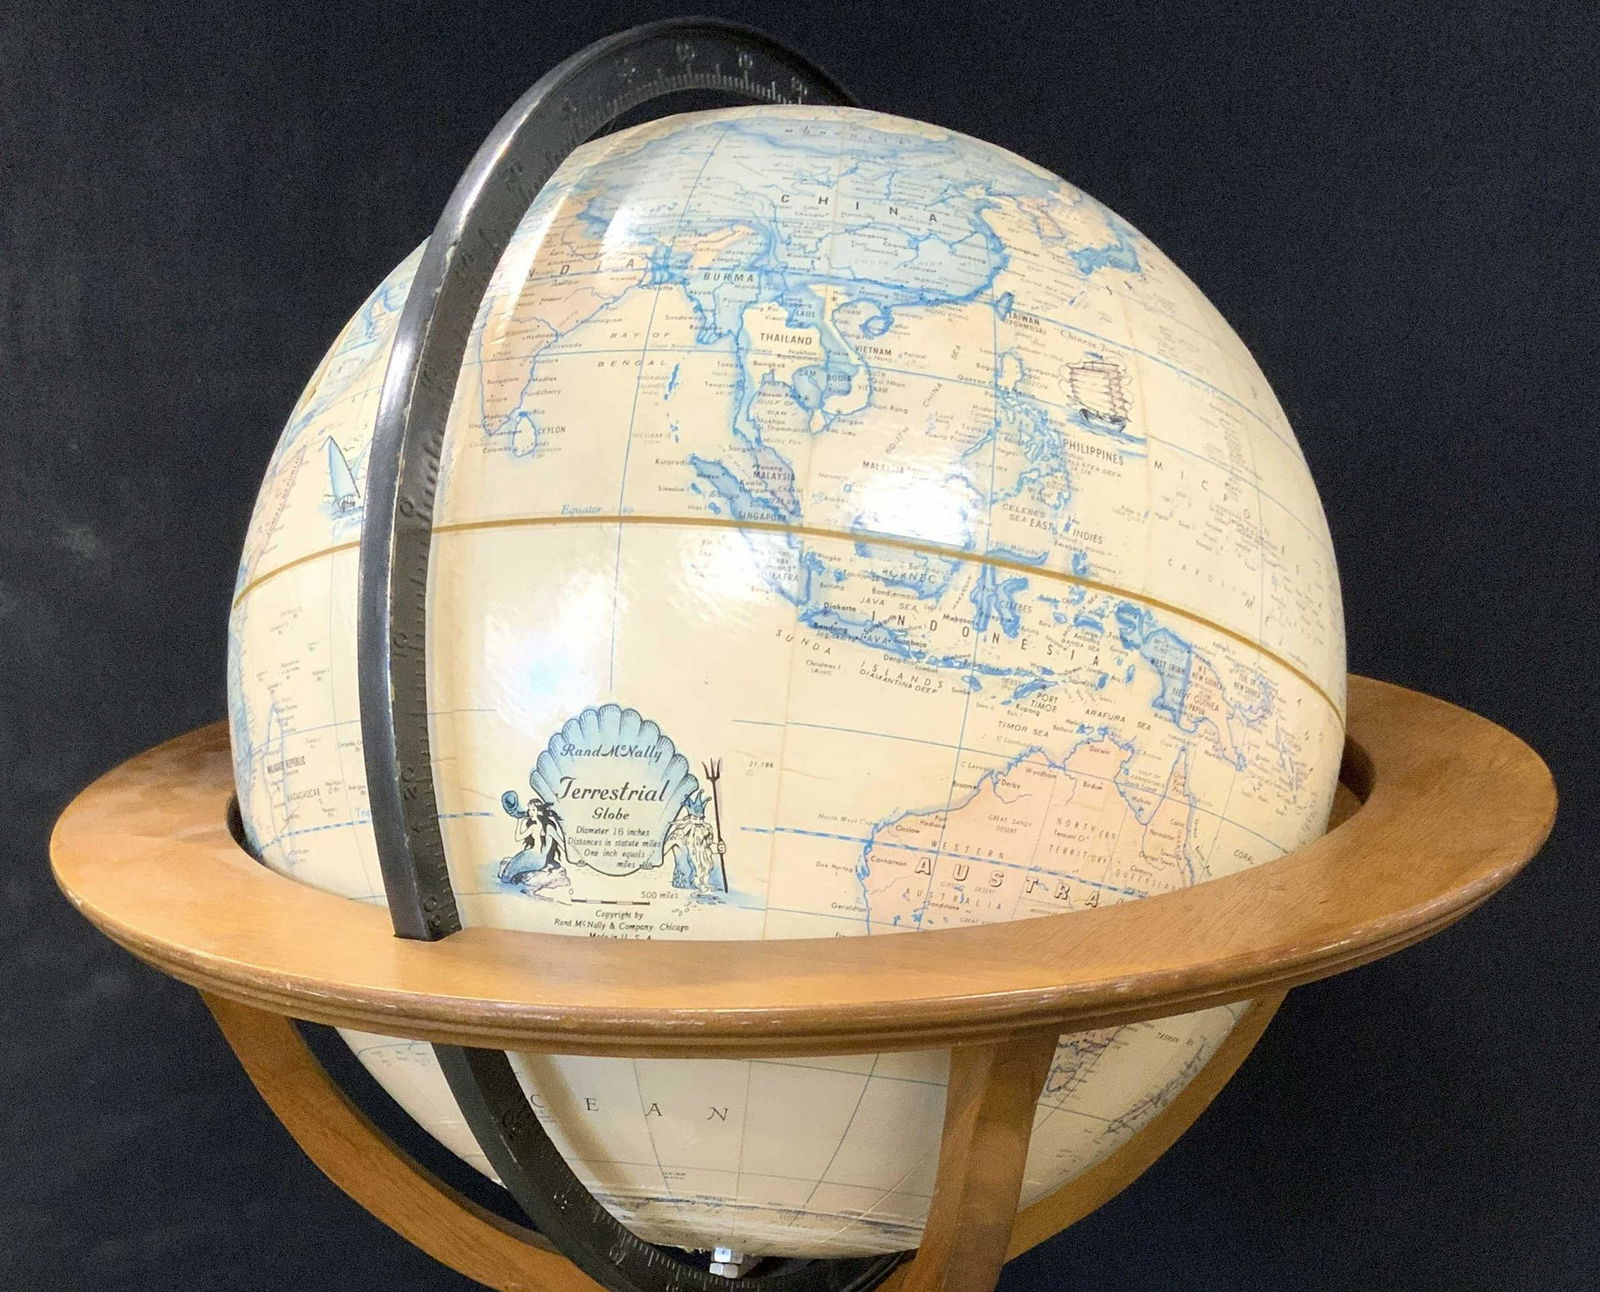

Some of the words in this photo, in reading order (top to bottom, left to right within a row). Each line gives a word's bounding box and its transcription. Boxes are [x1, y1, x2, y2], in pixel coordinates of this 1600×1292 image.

[781, 194, 938, 222] CHINA
[500, 258, 635, 279] DIA
[703, 272, 754, 281] BURMA
[796, 310, 815, 318] LAOS
[1008, 312, 1040, 326] TAIWAN
[760, 333, 812, 345] THAILAND
[855, 345, 891, 356] VIETNAM
[753, 360, 786, 368] Bangkok
[922, 383, 943, 407] CHINA
[538, 426, 566, 434] CEYLON
[1063, 438, 1124, 465] PHILIPPINES
[754, 471, 795, 481] MALAYSIA
[561, 504, 603, 516] Equator
[1002, 503, 1045, 518] CELEBES
[738, 512, 787, 521] SINGAPORE
[1009, 514, 1026, 522] SEA
[1030, 518, 1053, 531] EAST
[1072, 528, 1103, 544] INDIES
[824, 602, 856, 612] Djakarta
[860, 598, 885, 606] JAVA
[899, 603, 918, 612] SEA
[814, 622, 848, 634] Bandung
[860, 633, 888, 644] JAVA
[871, 611, 1099, 666] INDONESIA
[775, 629, 832, 656] SUNDA
[861, 661, 944, 689] ISLANDS
[1151, 657, 1167, 668] WEST
[859, 668, 913, 689] DIAMANTINA
[915, 685, 938, 695] DEEP
[1036, 692, 1058, 702] PORT
[1171, 687, 1190, 699] NEW
[1193, 695, 1219, 712] GUINEA
[1016, 703, 1040, 717] Kupang
[1031, 700, 1057, 713] TIMOR
[1085, 709, 1126, 723] ARAFURA
[1137, 721, 1151, 730] SEA
[998, 720, 1028, 732] TIMOR
[1033, 729, 1049, 737] SEA
[560, 743, 602, 757] Rand
[601, 744, 662, 763] McNally
[1089, 745, 1110, 754] Darwin
[1025, 767, 1057, 779] Wyndham
[555, 776, 670, 801] Terrestrial
[1001, 778, 1020, 790] Derby
[1083, 781, 1103, 790] Birdum
[355, 807, 371, 818] Trop
[592, 807, 629, 820] Globe
[988, 814, 1007, 822] GREAT
[576, 826, 608, 834] Diameter
[613, 827, 624, 835] 16
[627, 827, 650, 836] inches
[895, 825, 920, 834] Onslow
[996, 826, 1017, 834] DESERT
[1057, 817, 1116, 840] NORTHERN
[567, 837, 602, 846] Distances
[642, 840, 661, 848] miles
[584, 849, 599, 857] One
[603, 849, 617, 857] inch
[622, 851, 645, 859] equals
[932, 840, 1004, 859] WESTERN
[1049, 844, 1112, 863] TERRITORY
[870, 855, 907, 867] Carnarvon
[1233, 849, 1255, 865] CORAL
[915, 857, 1124, 908] AUSTRA
[1115, 870, 1176, 890] QUEENSLAN
[568, 888, 574, 896] 0
[641, 891, 657, 899] 500
[904, 888, 1002, 910] AUSTRALIA
[831, 902, 867, 912] Geraldton
[595, 910, 631, 920] Copyright
[634, 911, 644, 920] by
[554, 918, 572, 927] Rand
[619, 921, 654, 932] Company
[659, 923, 690, 933] Chicago
[531, 1093, 728, 1122] CEAN
